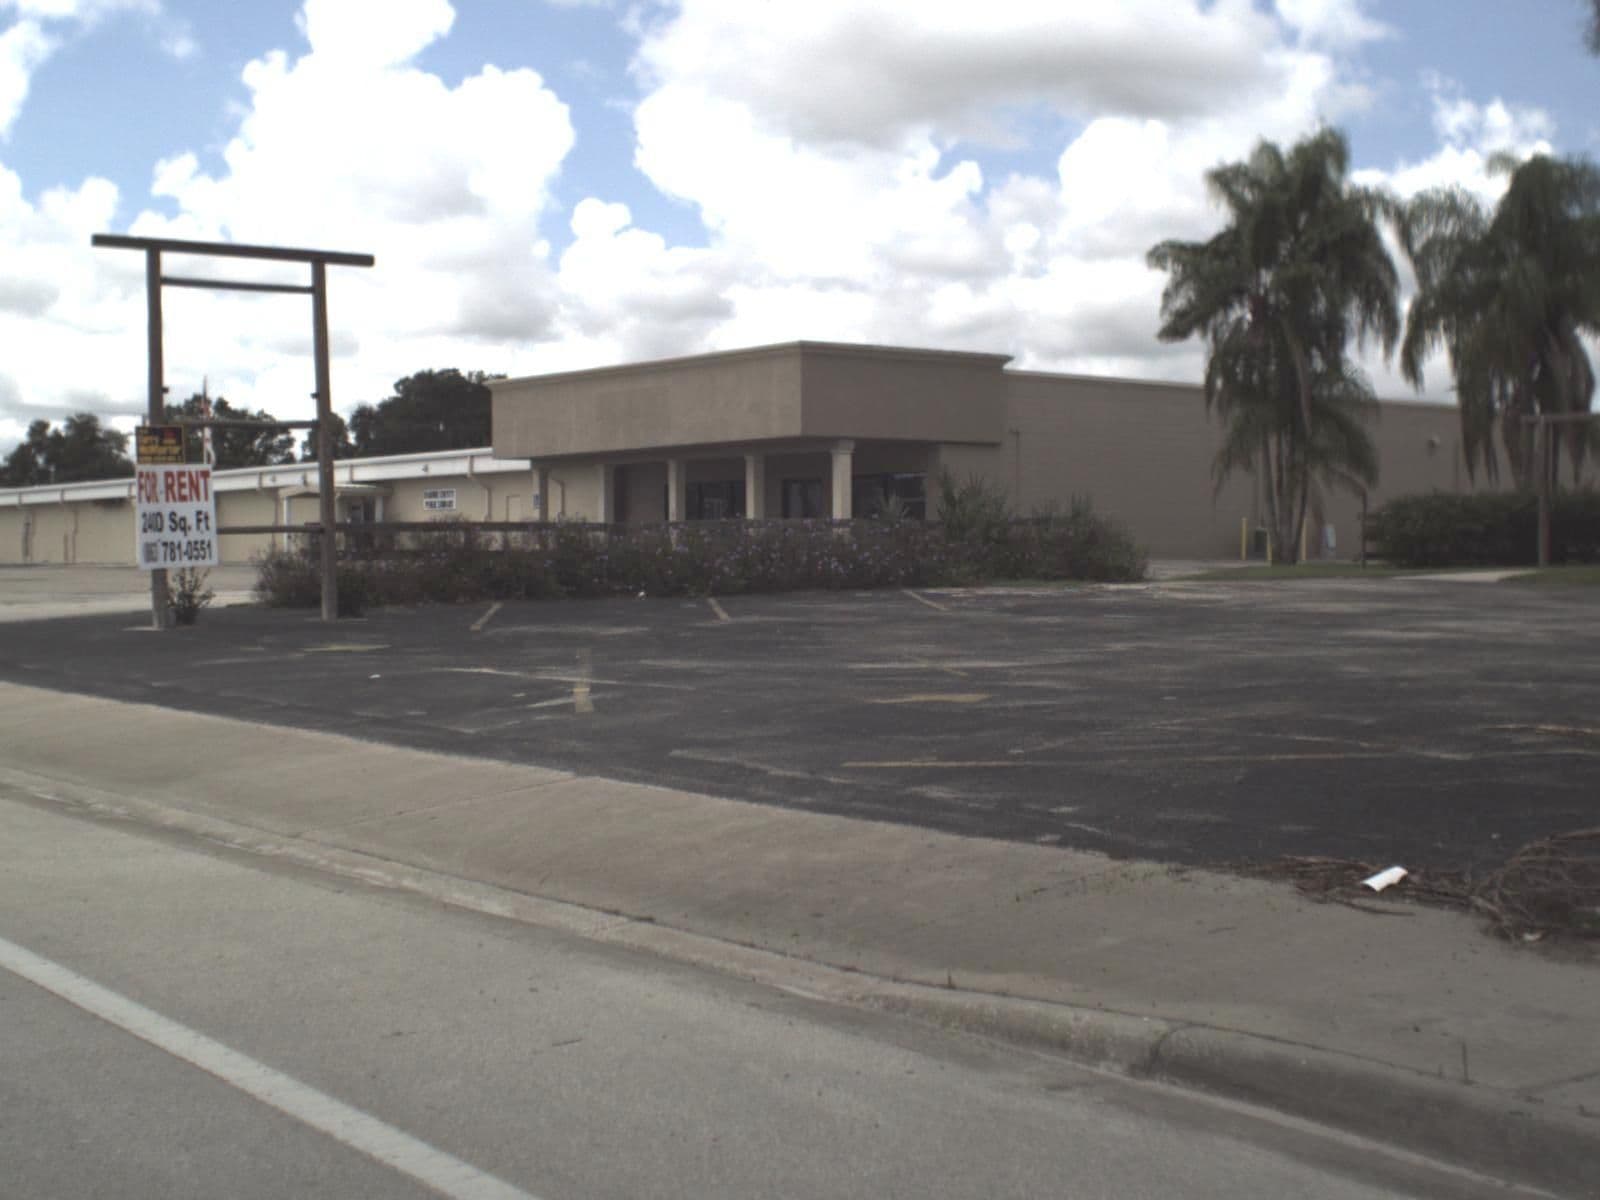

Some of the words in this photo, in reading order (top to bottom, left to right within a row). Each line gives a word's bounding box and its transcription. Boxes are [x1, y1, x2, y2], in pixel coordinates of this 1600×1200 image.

[137, 471, 159, 504] FOR
[164, 470, 210, 503] RENT
[168, 510, 192, 536] Sq.
[195, 509, 210, 532] Ft
[162, 540, 212, 563] 781-0551
